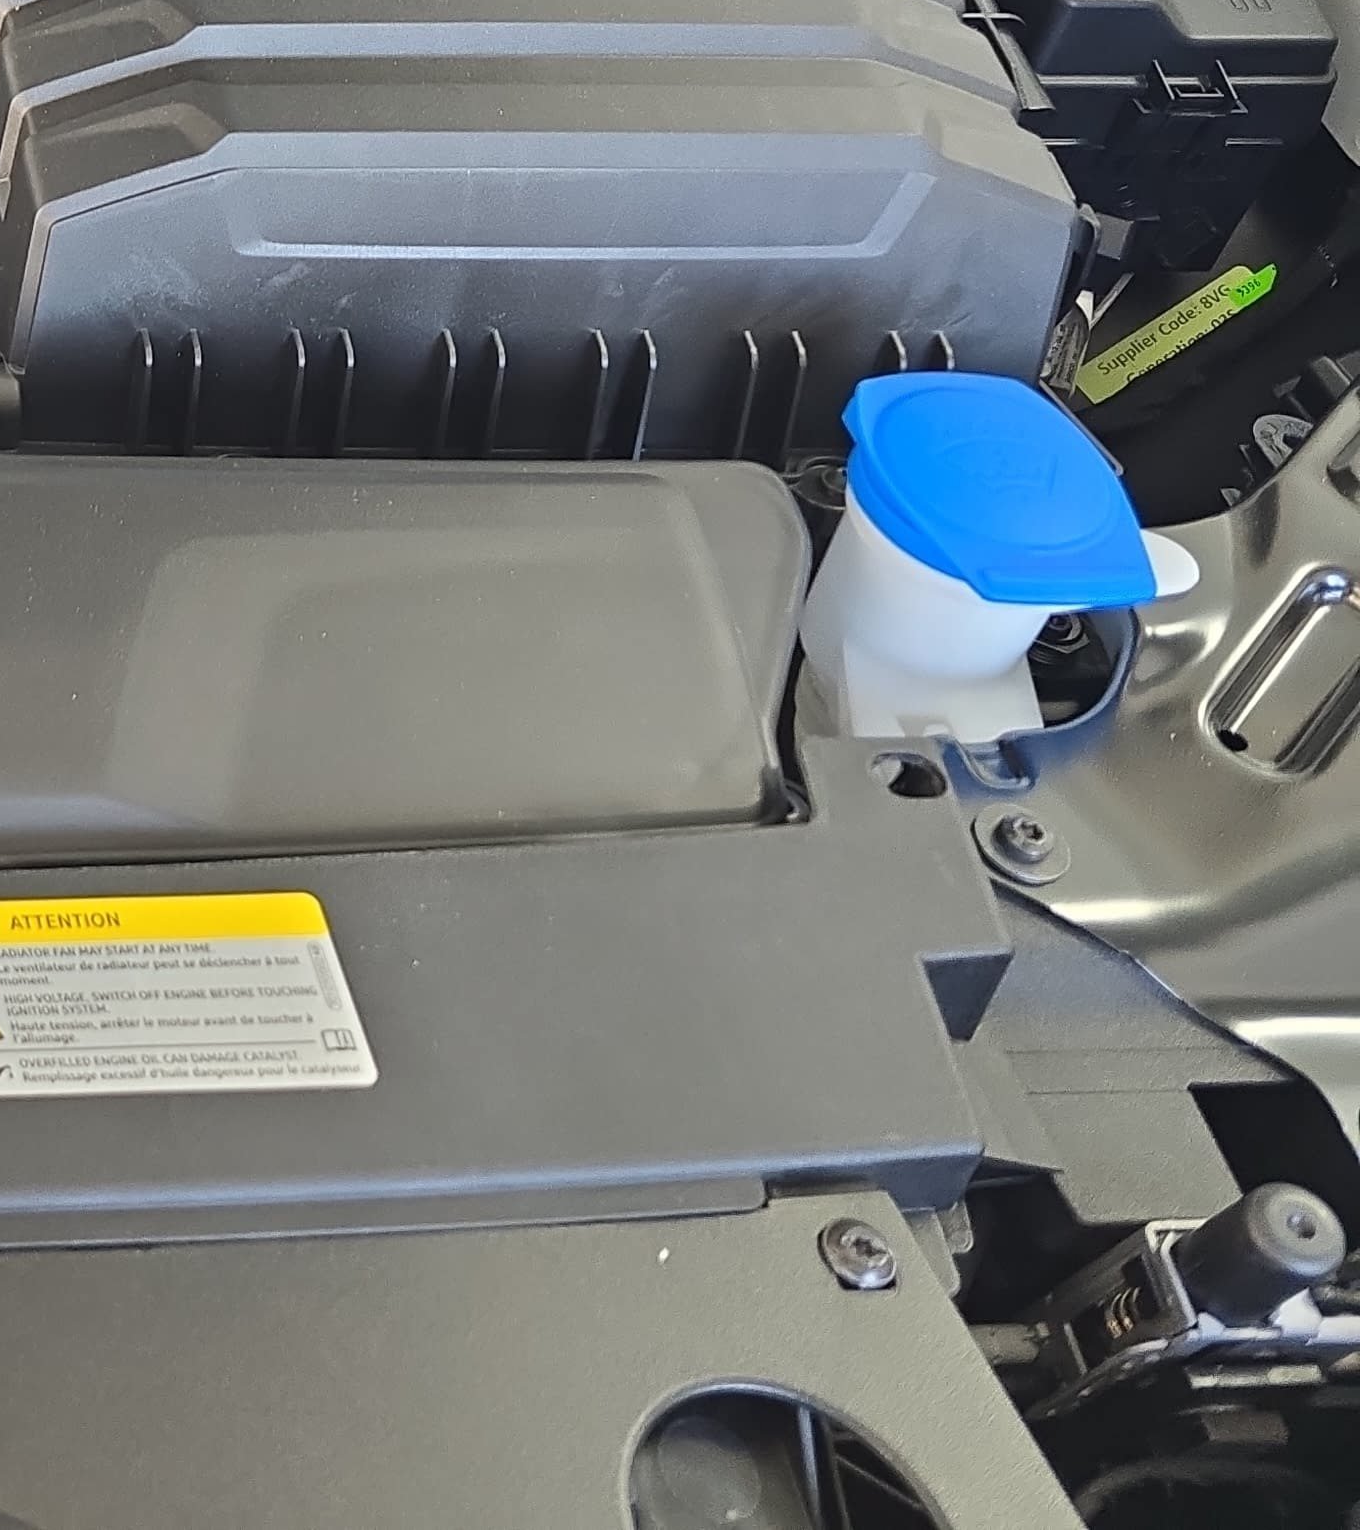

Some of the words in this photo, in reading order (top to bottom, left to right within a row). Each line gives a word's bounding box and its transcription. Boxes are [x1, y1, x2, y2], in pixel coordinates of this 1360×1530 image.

[1096, 331, 1158, 375] Supplier
[1158, 306, 1201, 336] Code:
[10, 912, 121, 930] ATTENTION
[53, 946, 76, 957] FAN
[79, 945, 103, 956] MAY
[106, 944, 140, 956] START
[142, 944, 156, 955] AT
[159, 943, 181, 954] ANY
[13, 962, 76, 973] ventilateur
[79, 961, 94, 971] de
[97, 959, 150, 970] radiateur
[3, 994, 33, 1004] HIGH
[92, 991, 137, 1002] SWITCH
[139, 990, 161, 1000] OFF
[164, 988, 207, 1000] ENGINE
[210, 987, 255, 999] BEFORE
[258, 985, 318, 998] TOUCHING
[7, 1006, 59, 1017] IGNITION
[94, 1055, 138, 1066] ENGINE
[163, 1052, 188, 1064] CAN
